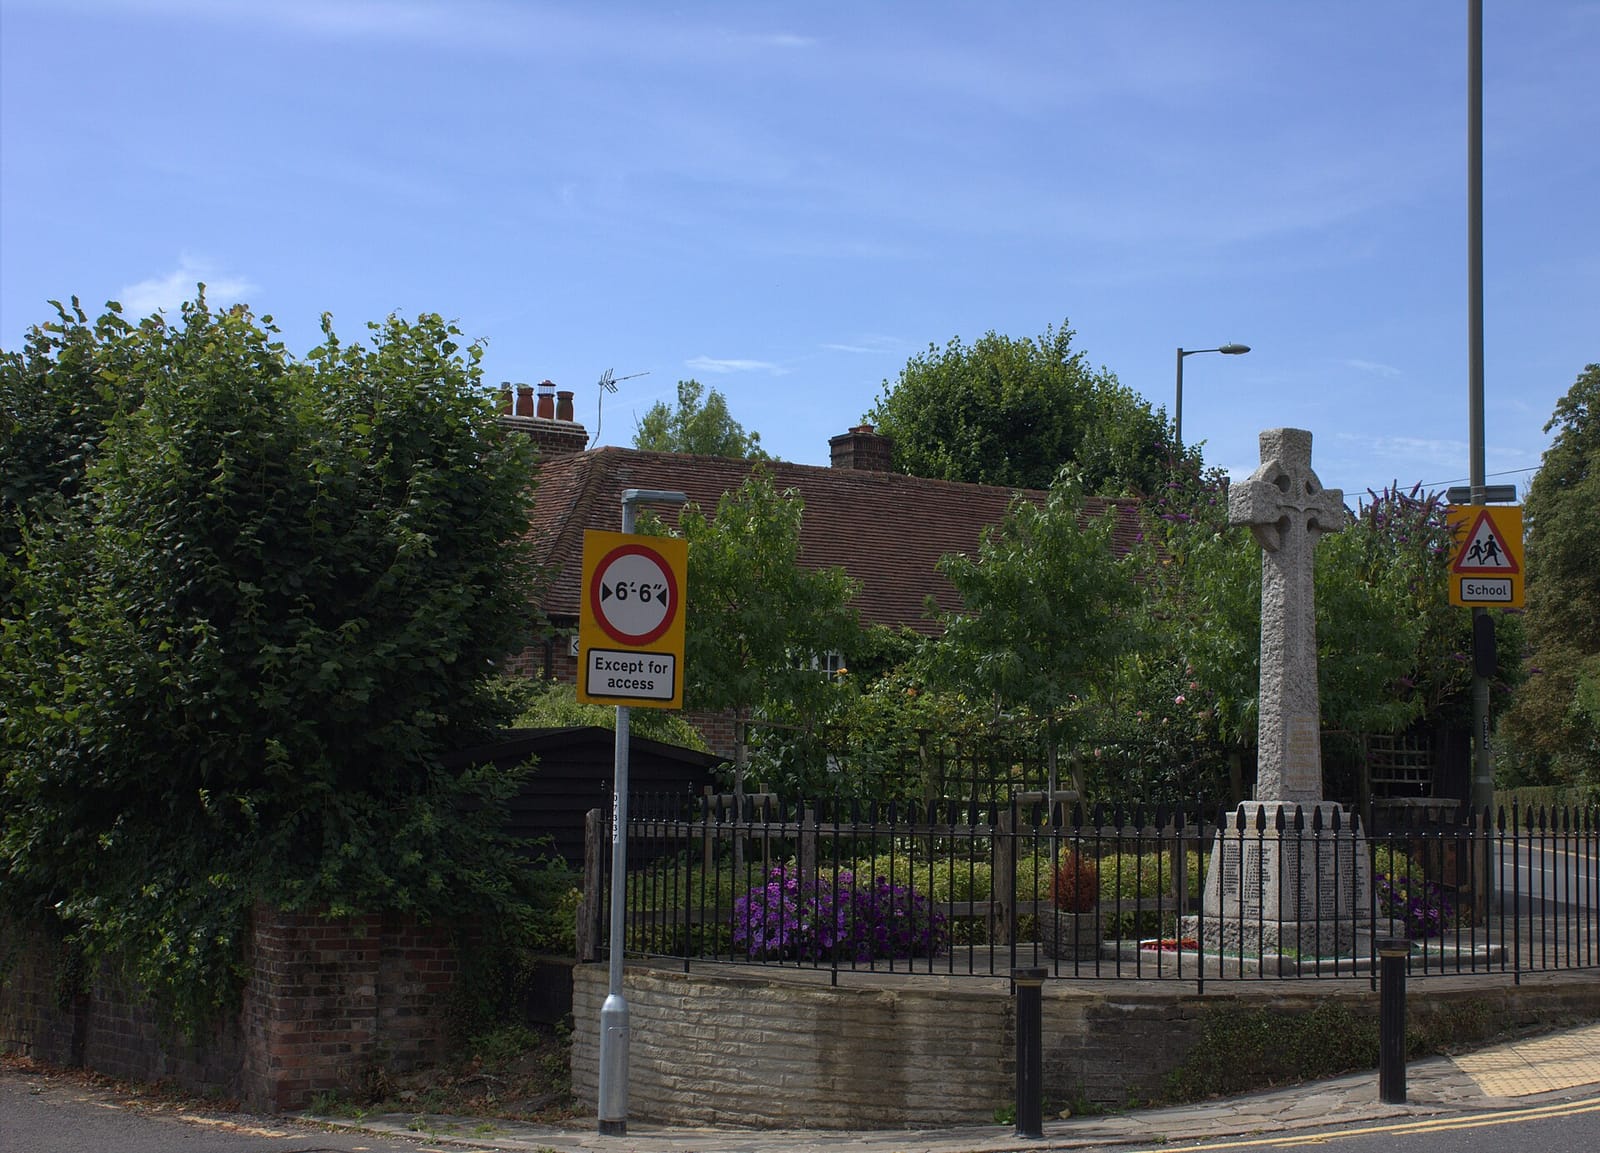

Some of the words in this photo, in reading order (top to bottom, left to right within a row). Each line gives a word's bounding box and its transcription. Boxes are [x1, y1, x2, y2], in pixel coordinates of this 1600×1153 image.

[1467, 584, 1507, 596] School
[595, 657, 644, 674] Except
[648, 661, 668, 674] for
[607, 678, 654, 690] access
